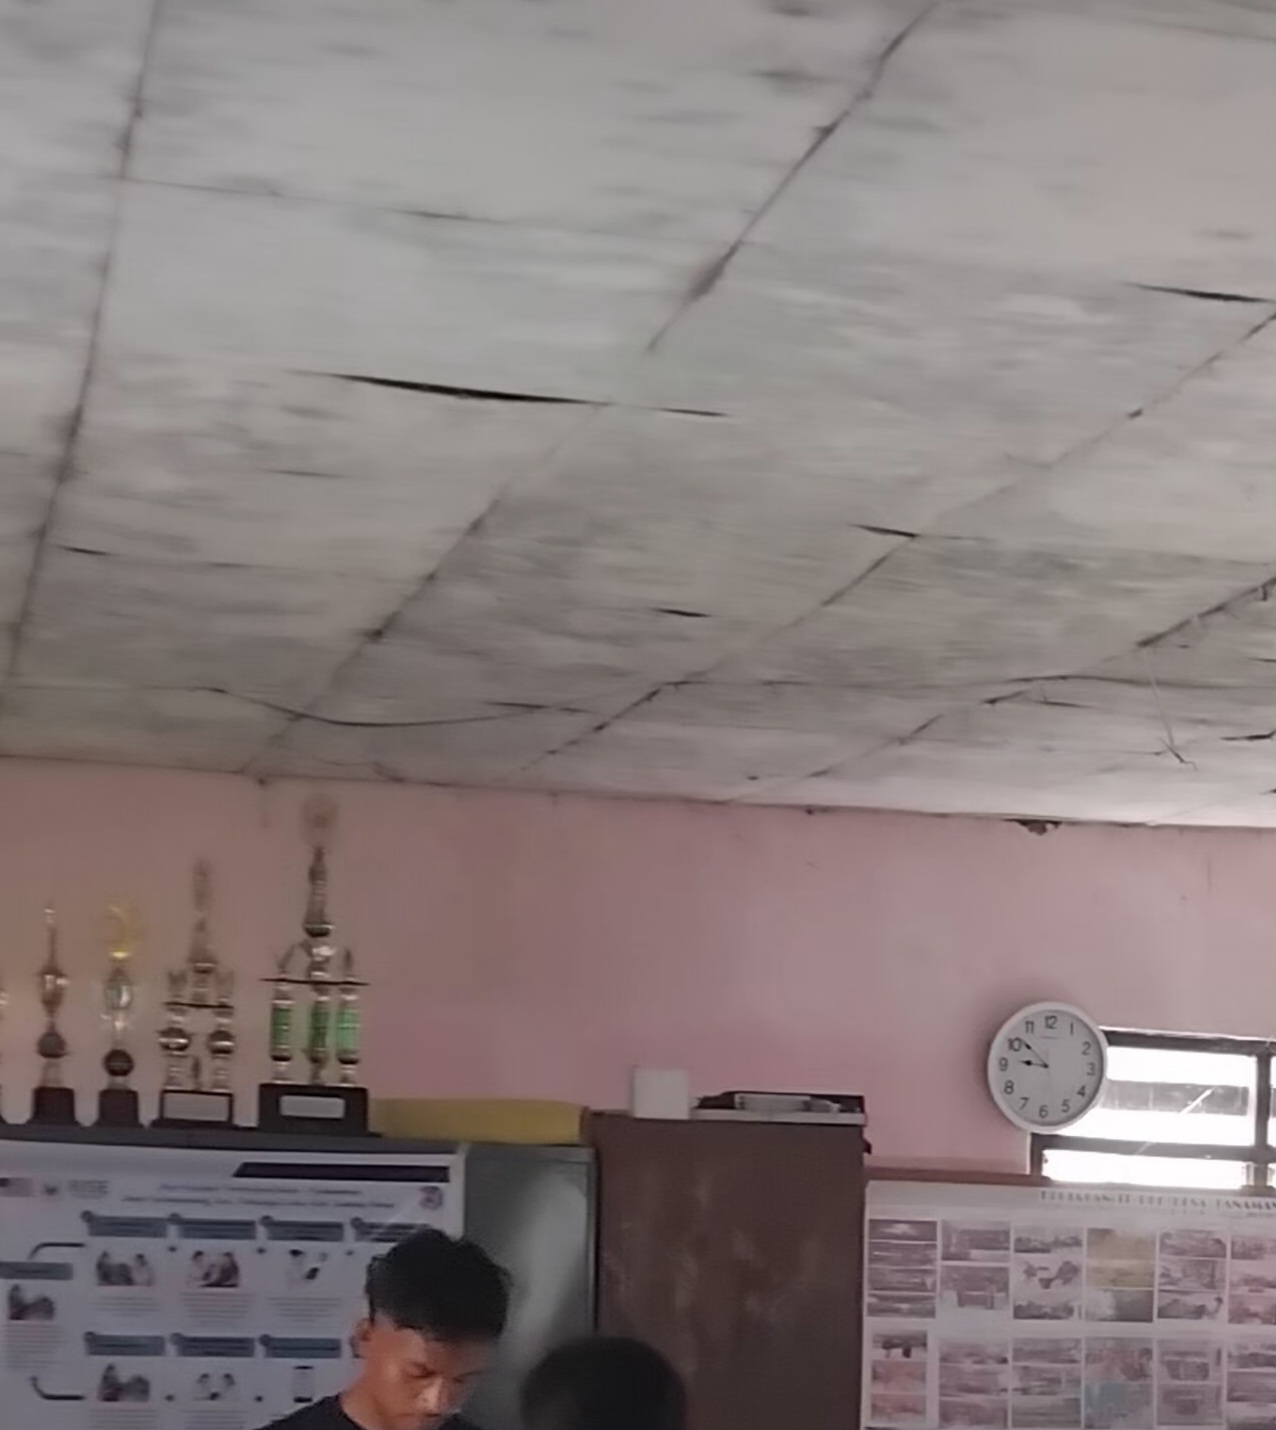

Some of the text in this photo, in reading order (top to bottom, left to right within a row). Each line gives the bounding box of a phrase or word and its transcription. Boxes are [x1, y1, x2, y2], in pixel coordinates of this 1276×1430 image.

[1025, 1020, 1035, 1035] 11
[1044, 1015, 1058, 1030] 12
[1007, 1036, 1023, 1052] 10
[1081, 1041, 1092, 1056] 2
[998, 1057, 1009, 1072] 9
[1086, 1062, 1096, 1077] 3
[1003, 1080, 1015, 1095] 8
[1076, 1084, 1087, 1098] 4
[1019, 1096, 1030, 1110] 7
[1061, 1099, 1071, 1113] 5
[1038, 1104, 1049, 1119] 6
